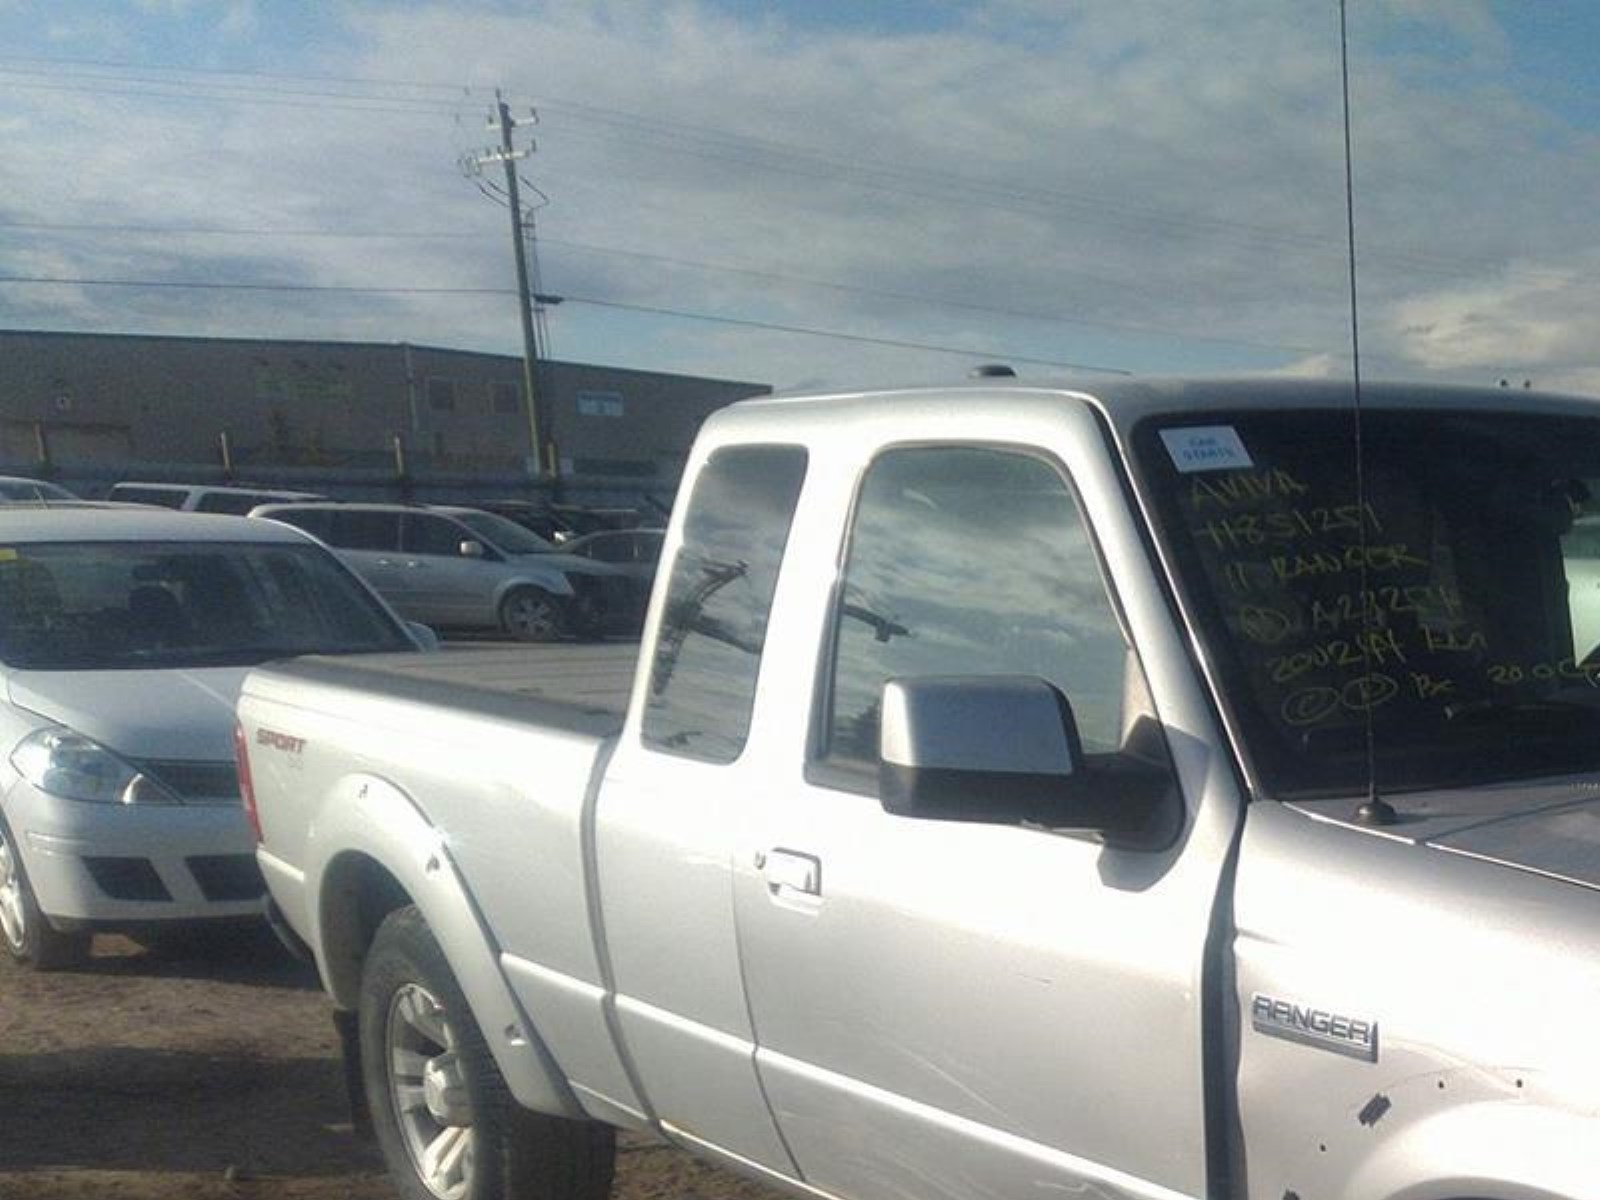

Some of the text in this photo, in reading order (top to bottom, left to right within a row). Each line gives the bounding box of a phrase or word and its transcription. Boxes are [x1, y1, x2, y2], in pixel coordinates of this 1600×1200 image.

[1191, 468, 1309, 511] AVIVA
[256, 727, 306, 753] SPORT
[1253, 995, 1370, 1043] RANGER
